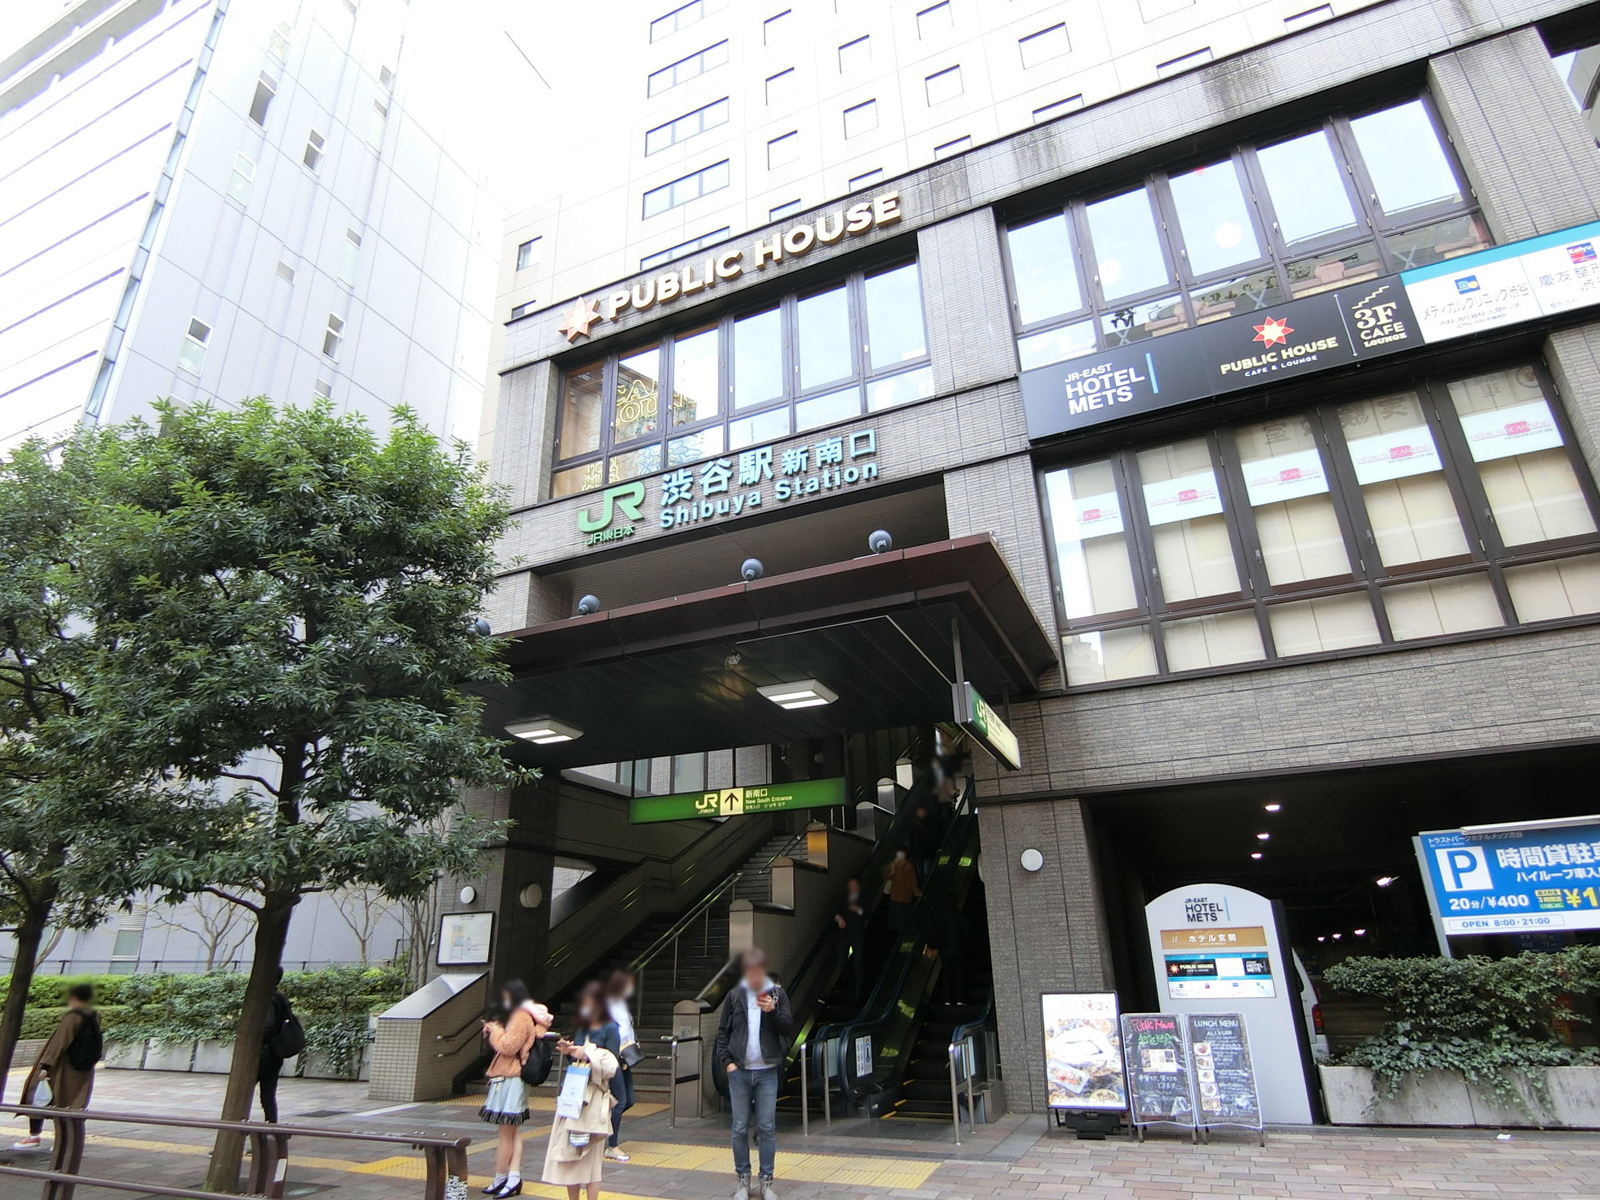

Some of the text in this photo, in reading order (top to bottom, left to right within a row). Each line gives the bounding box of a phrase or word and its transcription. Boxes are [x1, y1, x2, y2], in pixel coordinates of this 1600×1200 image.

[608, 191, 902, 322] PUBLIC HOUSE
[1354, 301, 1397, 330] 3F
[1359, 321, 1405, 341] CAFE
[1363, 332, 1407, 348] LOUNGE
[1220, 336, 1339, 375] PUBLIC HOUSE
[1244, 367, 1268, 377] CAFE
[1280, 354, 1318, 368] LOUNGE
[1064, 363, 1112, 383] JR-EAST
[1065, 367, 1145, 399] HOTEL
[1068, 386, 1133, 415] METS
[659, 446, 773, 507] 渋谷駅
[781, 428, 877, 475] 新南口
[659, 461, 879, 530] Shibuya Station
[577, 481, 646, 532] JR
[584, 525, 635, 546] JR東日本
[695, 793, 718, 809] JR
[746, 788, 768, 798] 新南口
[772, 795, 793, 803] Entrance
[1446, 850, 1478, 889] P
[1516, 866, 1600, 882] ハイルーフ車入
[1185, 903, 1223, 913] HOTEL
[1563, 887, 1600, 908] ¥1
[1186, 912, 1218, 922] METS
[1462, 920, 1489, 928] OPEN
[1193, 1019, 1239, 1028] LUNCH MENU
